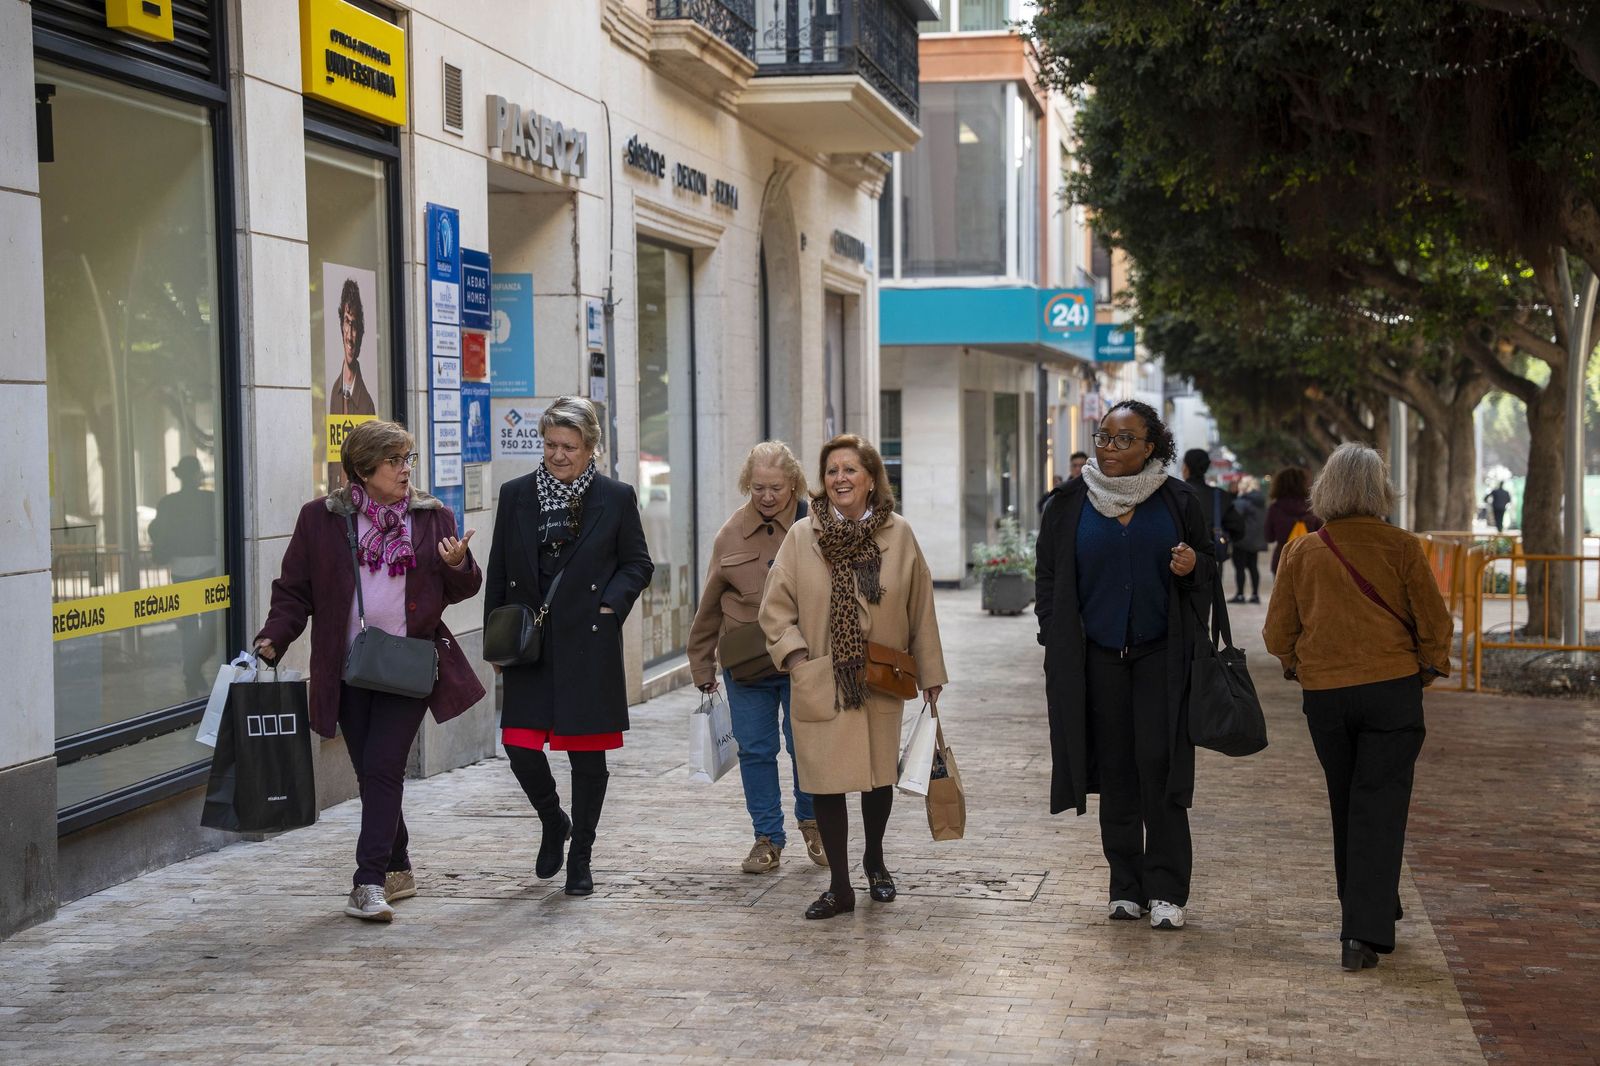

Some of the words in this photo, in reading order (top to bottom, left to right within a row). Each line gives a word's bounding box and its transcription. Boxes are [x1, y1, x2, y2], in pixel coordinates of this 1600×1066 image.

[486, 95, 564, 171] PASEO
[563, 128, 587, 178] 21
[677, 162, 707, 196] DEKTON
[466, 275, 486, 289] AEDAS
[467, 290, 486, 305] HOMES
[501, 428, 513, 438] SE
[501, 440, 518, 449] 950
[522, 440, 533, 449] 23
[134, 594, 180, 618] REBAJAS
[52, 607, 105, 634] REBAJAS
